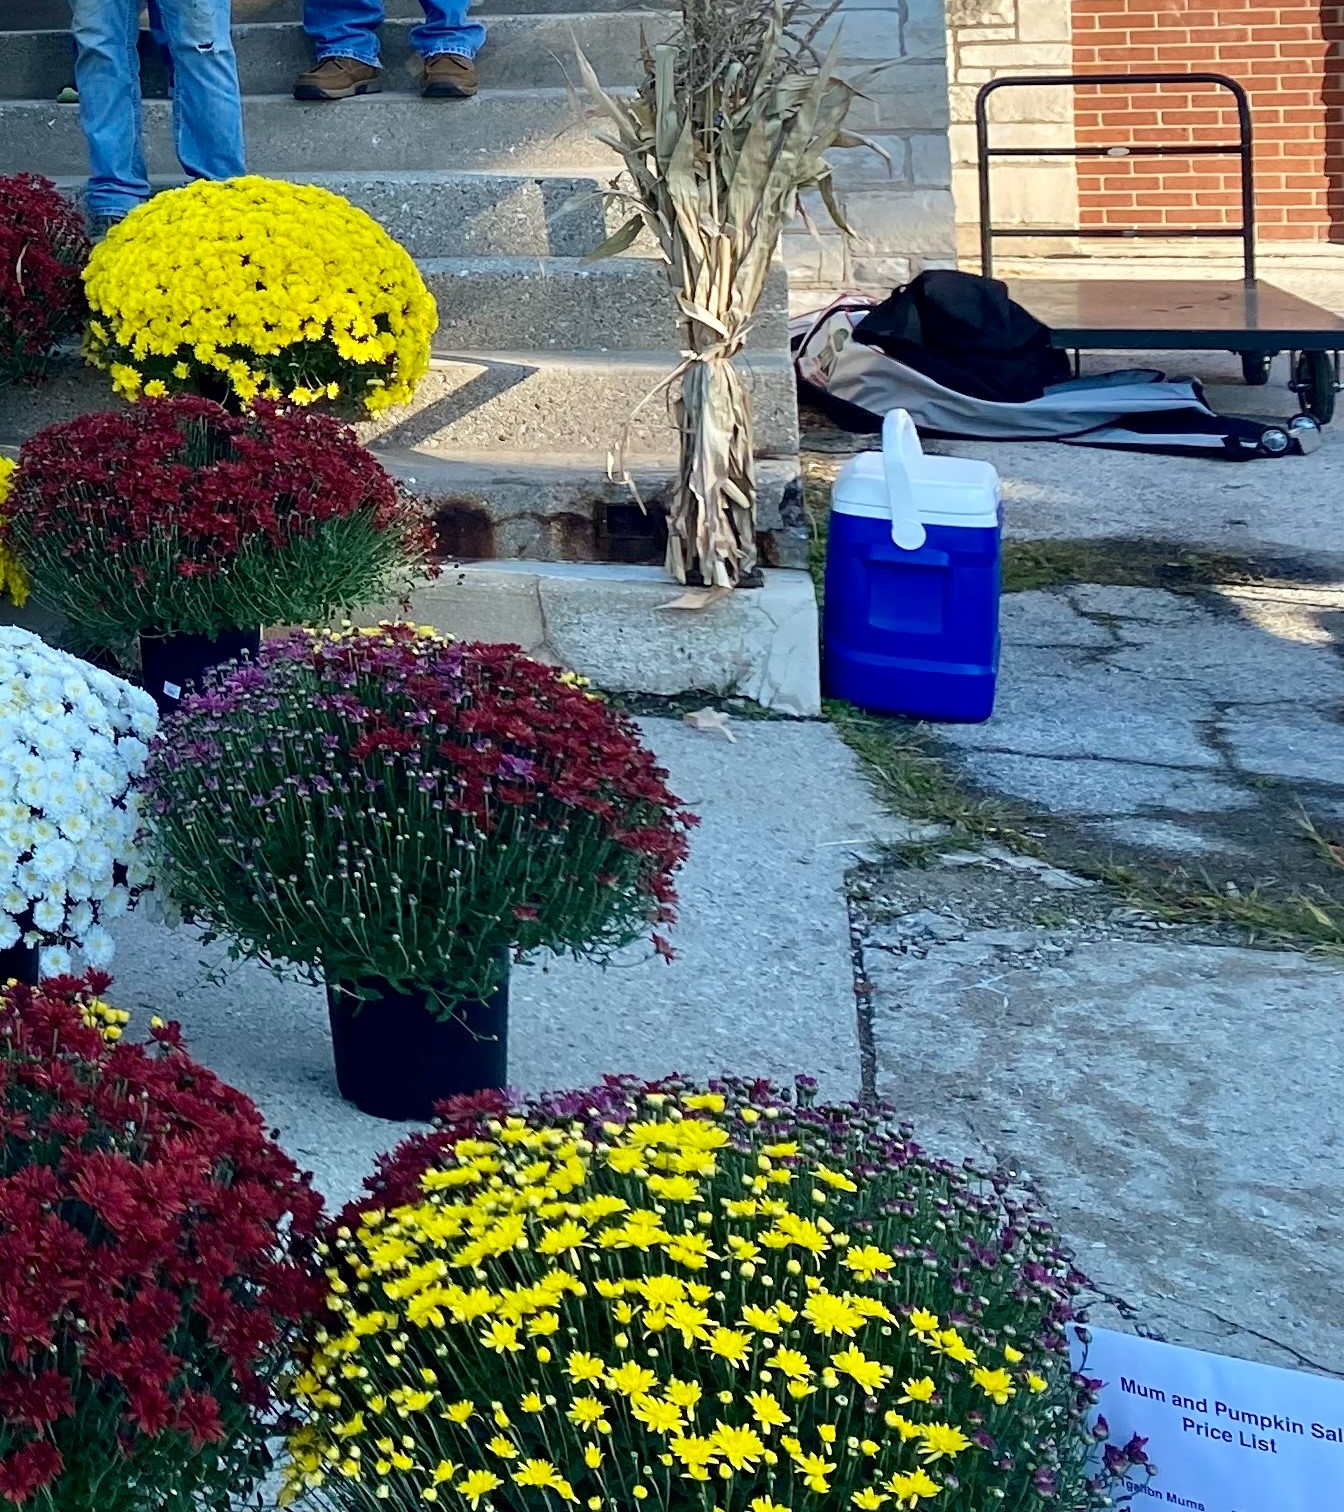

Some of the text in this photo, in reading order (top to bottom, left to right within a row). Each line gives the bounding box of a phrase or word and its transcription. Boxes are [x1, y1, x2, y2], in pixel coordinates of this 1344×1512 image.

[1120, 1377, 1344, 1443] Mum and Pumpkin Sal
[1182, 1417, 1278, 1454] Price List
[1166, 1491, 1205, 1512] Mums
